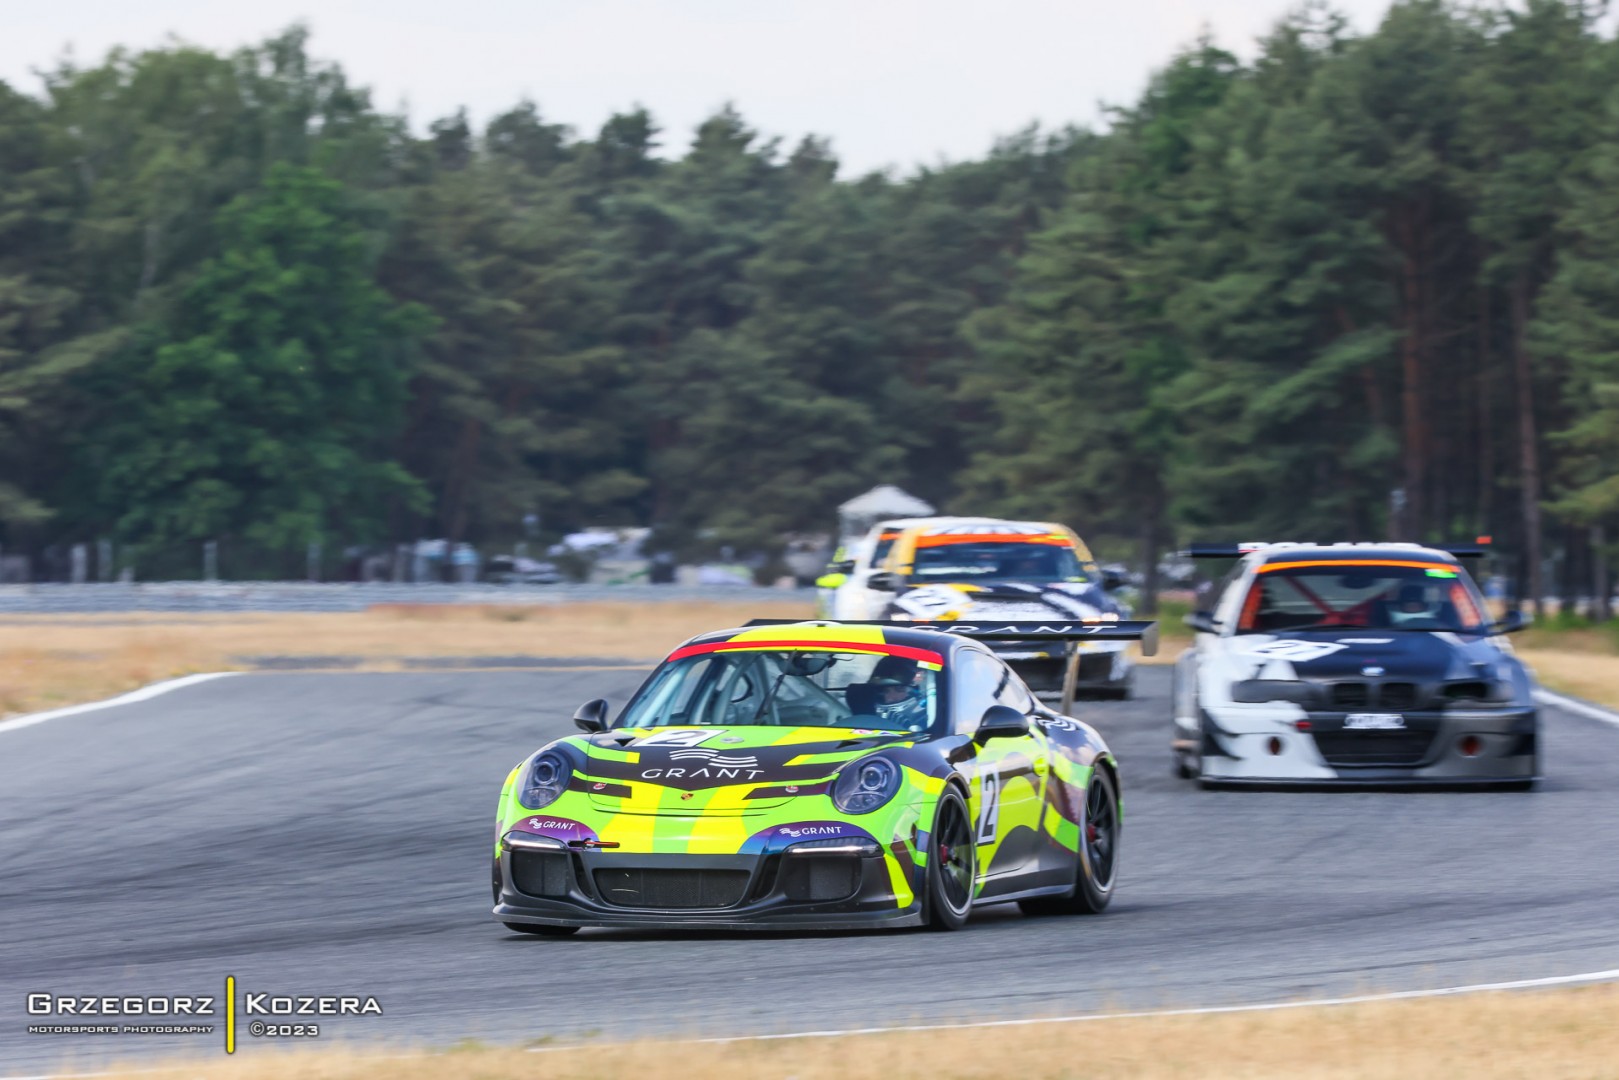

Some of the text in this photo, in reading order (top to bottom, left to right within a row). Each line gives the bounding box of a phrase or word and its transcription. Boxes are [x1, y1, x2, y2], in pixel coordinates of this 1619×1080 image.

[645, 730, 708, 745] 2
[640, 767, 765, 780] GRANT
[981, 772, 996, 838] 2
[542, 820, 576, 831] GRANT
[801, 826, 842, 835] GRANT
